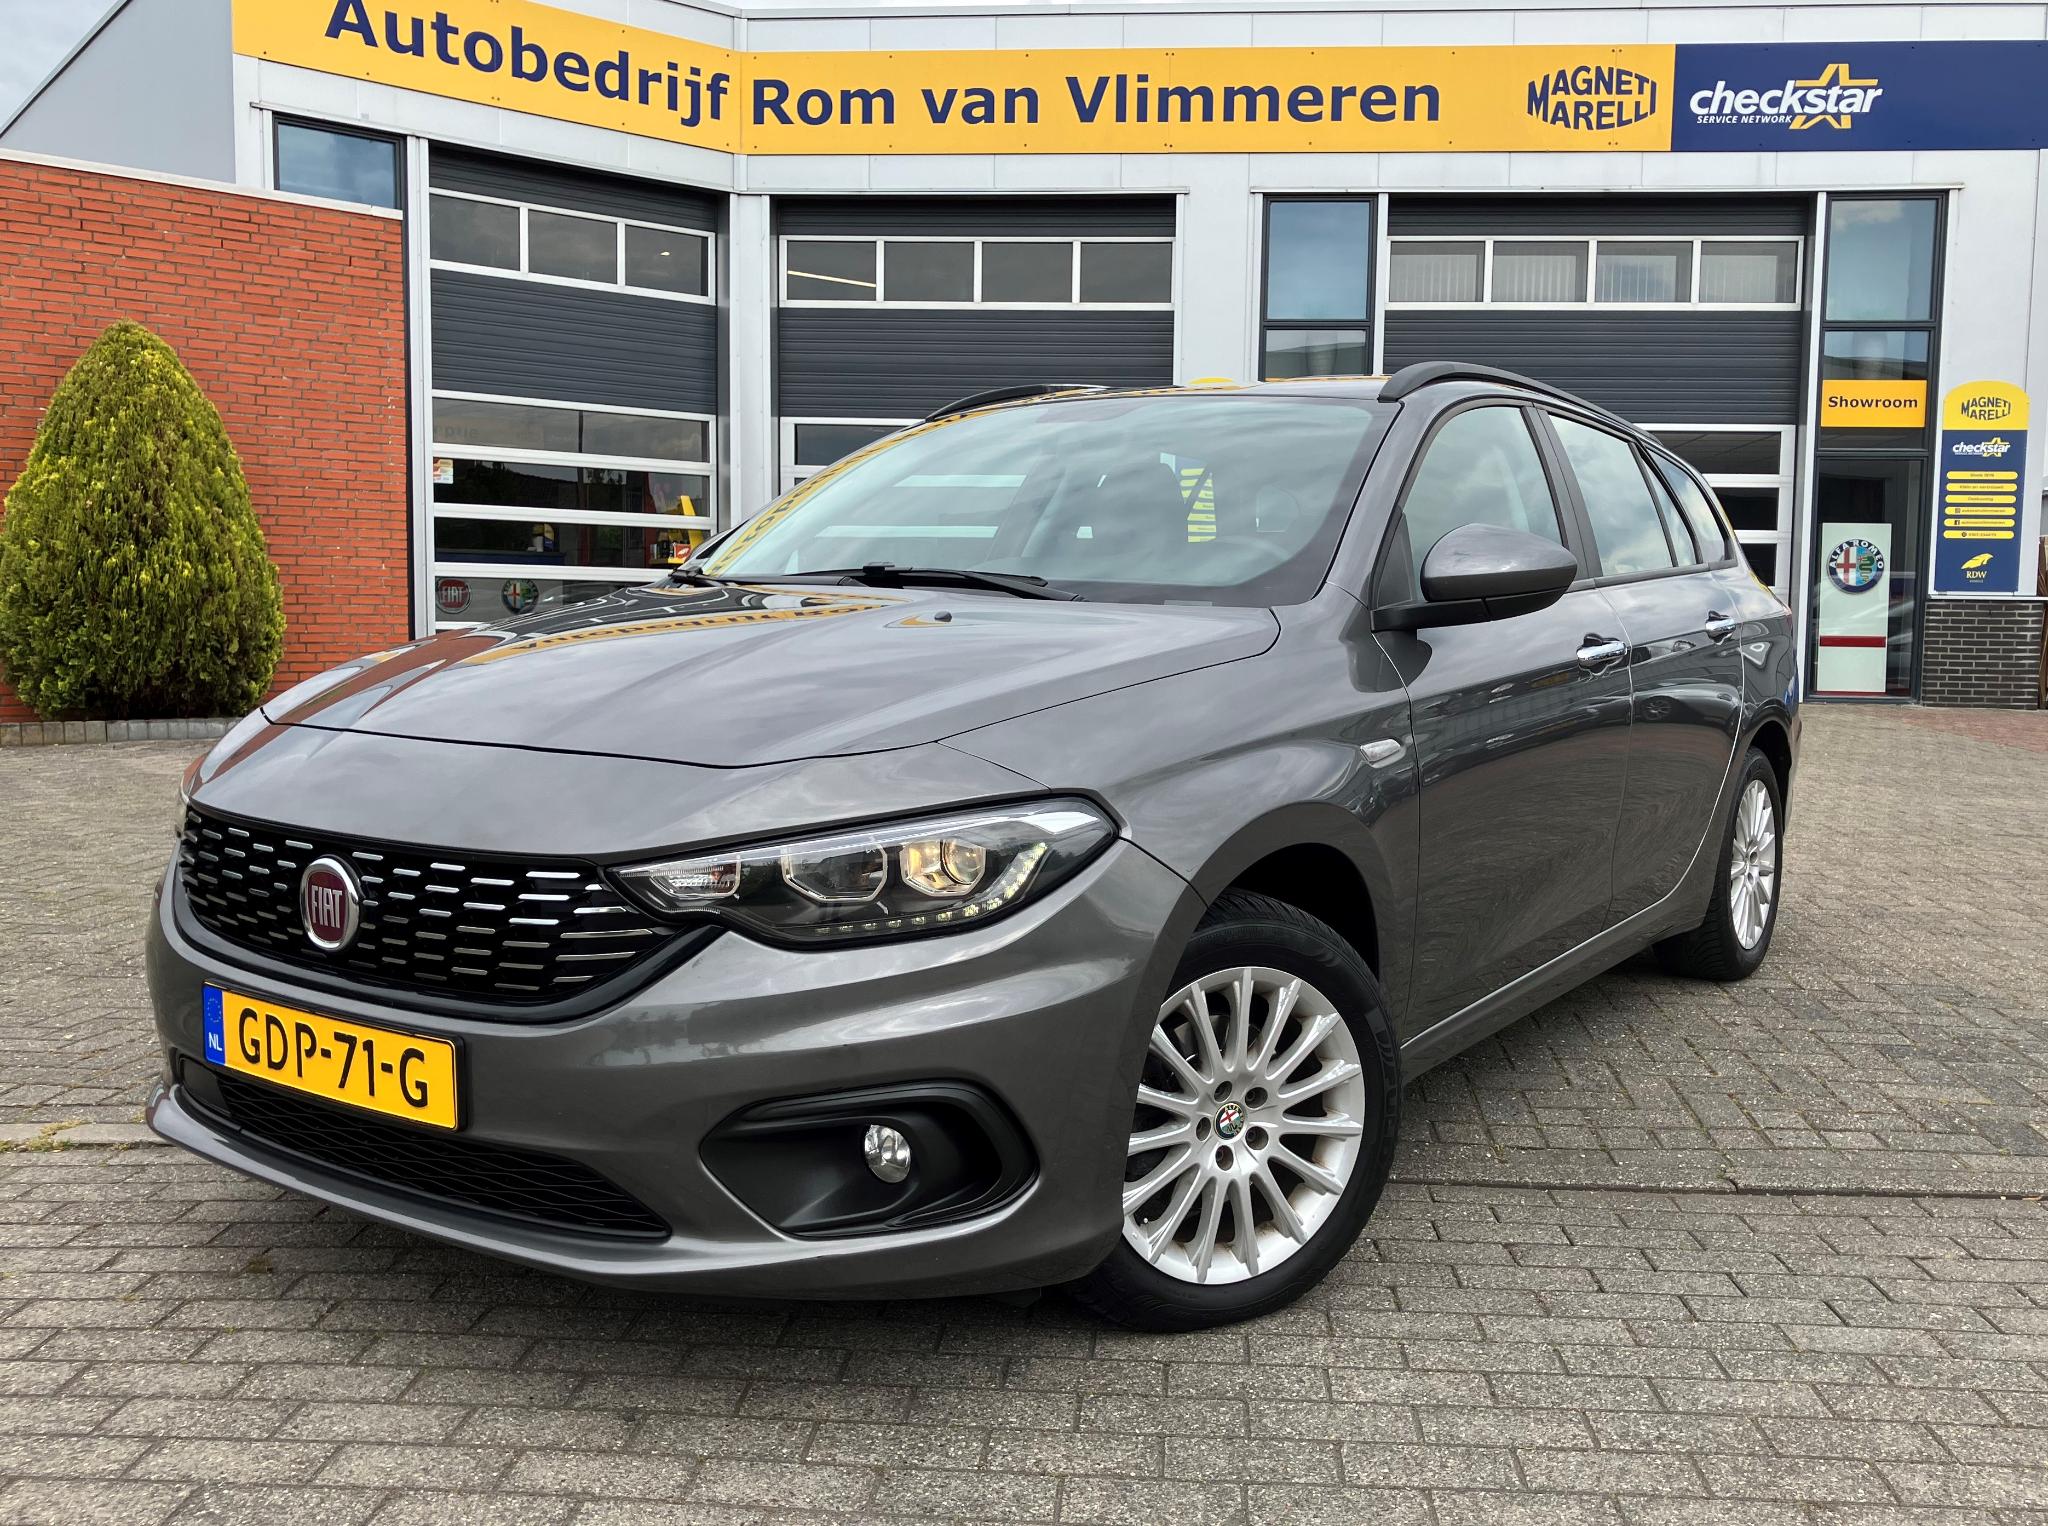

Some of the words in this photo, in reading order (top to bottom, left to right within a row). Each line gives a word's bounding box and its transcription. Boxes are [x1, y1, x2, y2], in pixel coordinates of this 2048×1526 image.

[324, 0, 730, 127] Autobedrijf
[753, 79, 895, 125] Rom
[921, 87, 1039, 125] van
[1065, 74, 1440, 123] Vlimmeren
[1527, 65, 1657, 110] MAGNETI
[1689, 80, 1883, 115] checkstar
[1527, 92, 1657, 131] MARELLI
[1697, 115, 1738, 124] SERVICE
[1740, 115, 1792, 124] NETWORK
[1828, 395, 1918, 409] Showroom
[1961, 396, 2011, 412] MAGNETI
[1961, 406, 2011, 421] MARELLI
[1952, 441, 2011, 453] checkstar
[1829, 542, 1849, 568] ALFA
[1850, 539, 1884, 569] ROMEO
[1966, 570, 1988, 579] RDW
[311, 884, 343, 929] FIAT
[208, 1031, 223, 1052] NL
[238, 1007, 428, 1108] GDP-71-G
